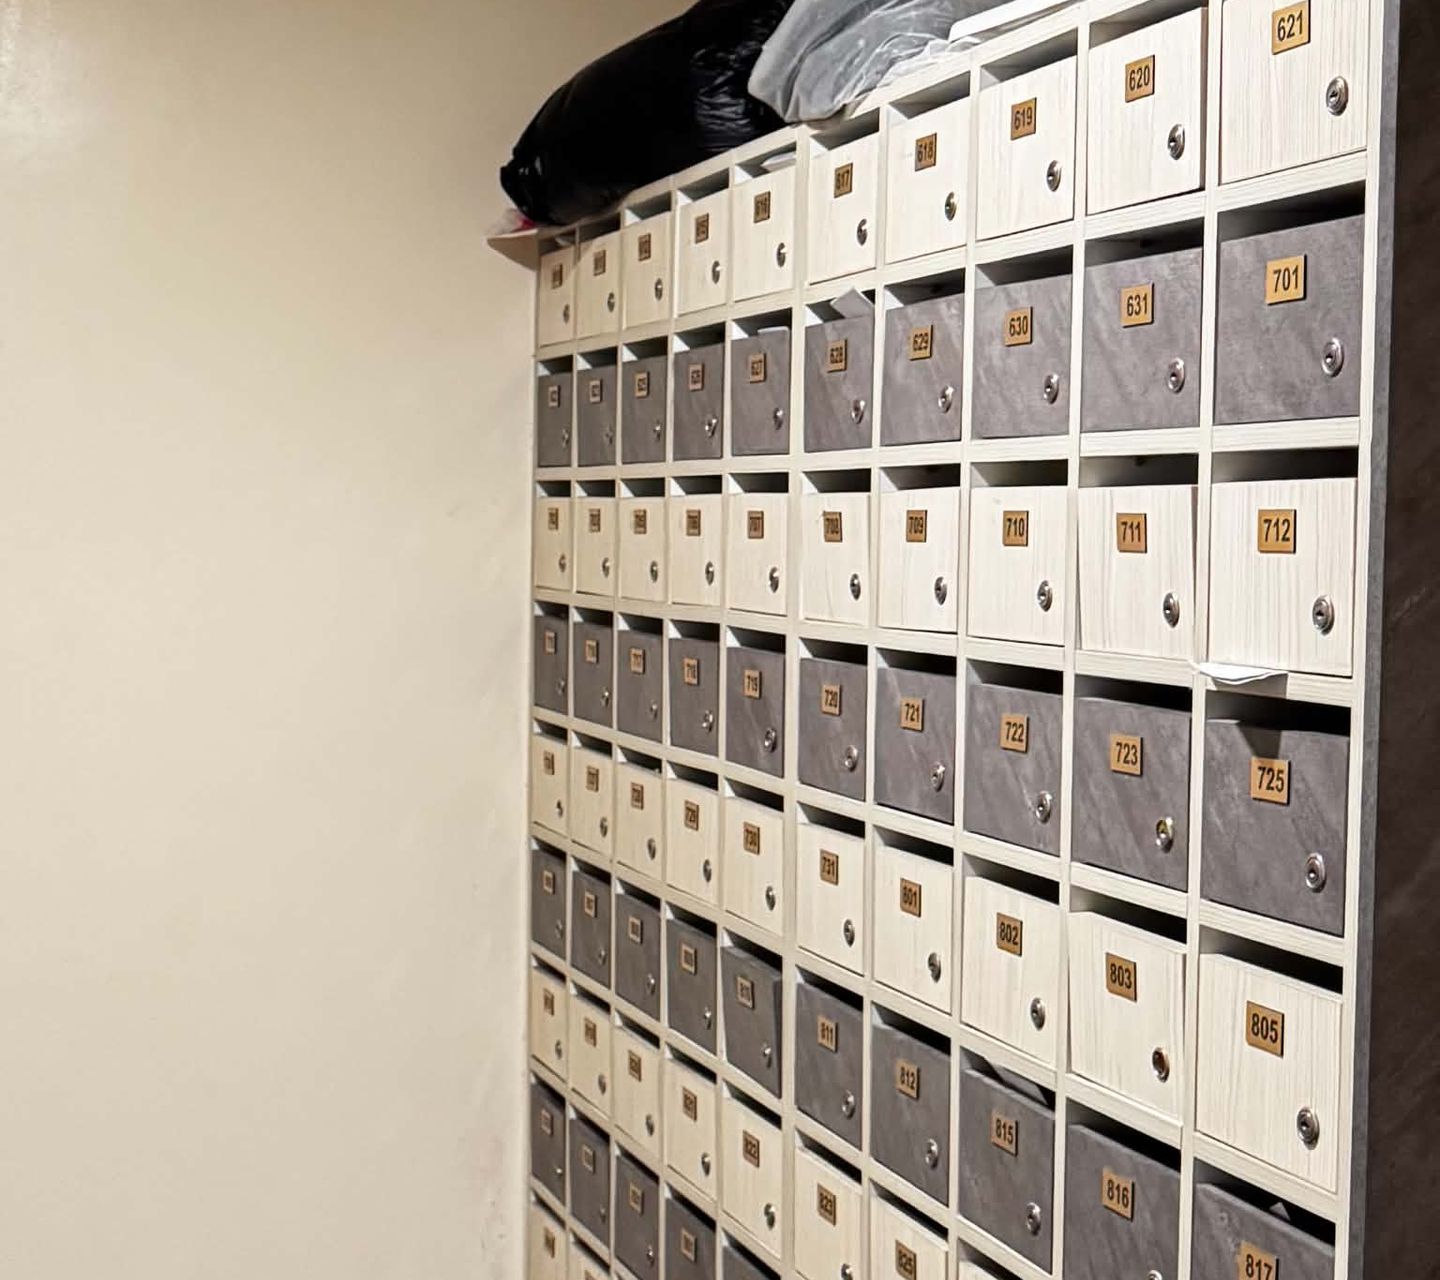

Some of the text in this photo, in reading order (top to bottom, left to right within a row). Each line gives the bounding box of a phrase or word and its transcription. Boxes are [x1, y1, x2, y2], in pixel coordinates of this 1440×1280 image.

[1277, 11, 1303, 41] 621
[1130, 66, 1150, 92] 620
[1015, 109, 1032, 130] 619
[917, 143, 933, 162] 618
[1273, 267, 1299, 293] 701
[1127, 292, 1148, 315] 631
[1009, 315, 1028, 336] 630
[913, 333, 928, 352] 629
[1007, 519, 1024, 537] 710
[1121, 521, 1141, 543] 711
[1264, 519, 1290, 542] 712
[905, 704, 919, 721] 721
[1006, 721, 1023, 741] 722
[1116, 742, 1137, 764] 723
[1258, 766, 1284, 793] 725
[822, 856, 836, 876] 731
[903, 888, 917, 908] 801
[1000, 923, 1017, 944] 802
[1110, 965, 1132, 990] 803
[1251, 1015, 1278, 1043] 805
[900, 1068, 915, 1090] 812
[995, 1118, 1014, 1145] 815
[1108, 1180, 1129, 1208] 816
